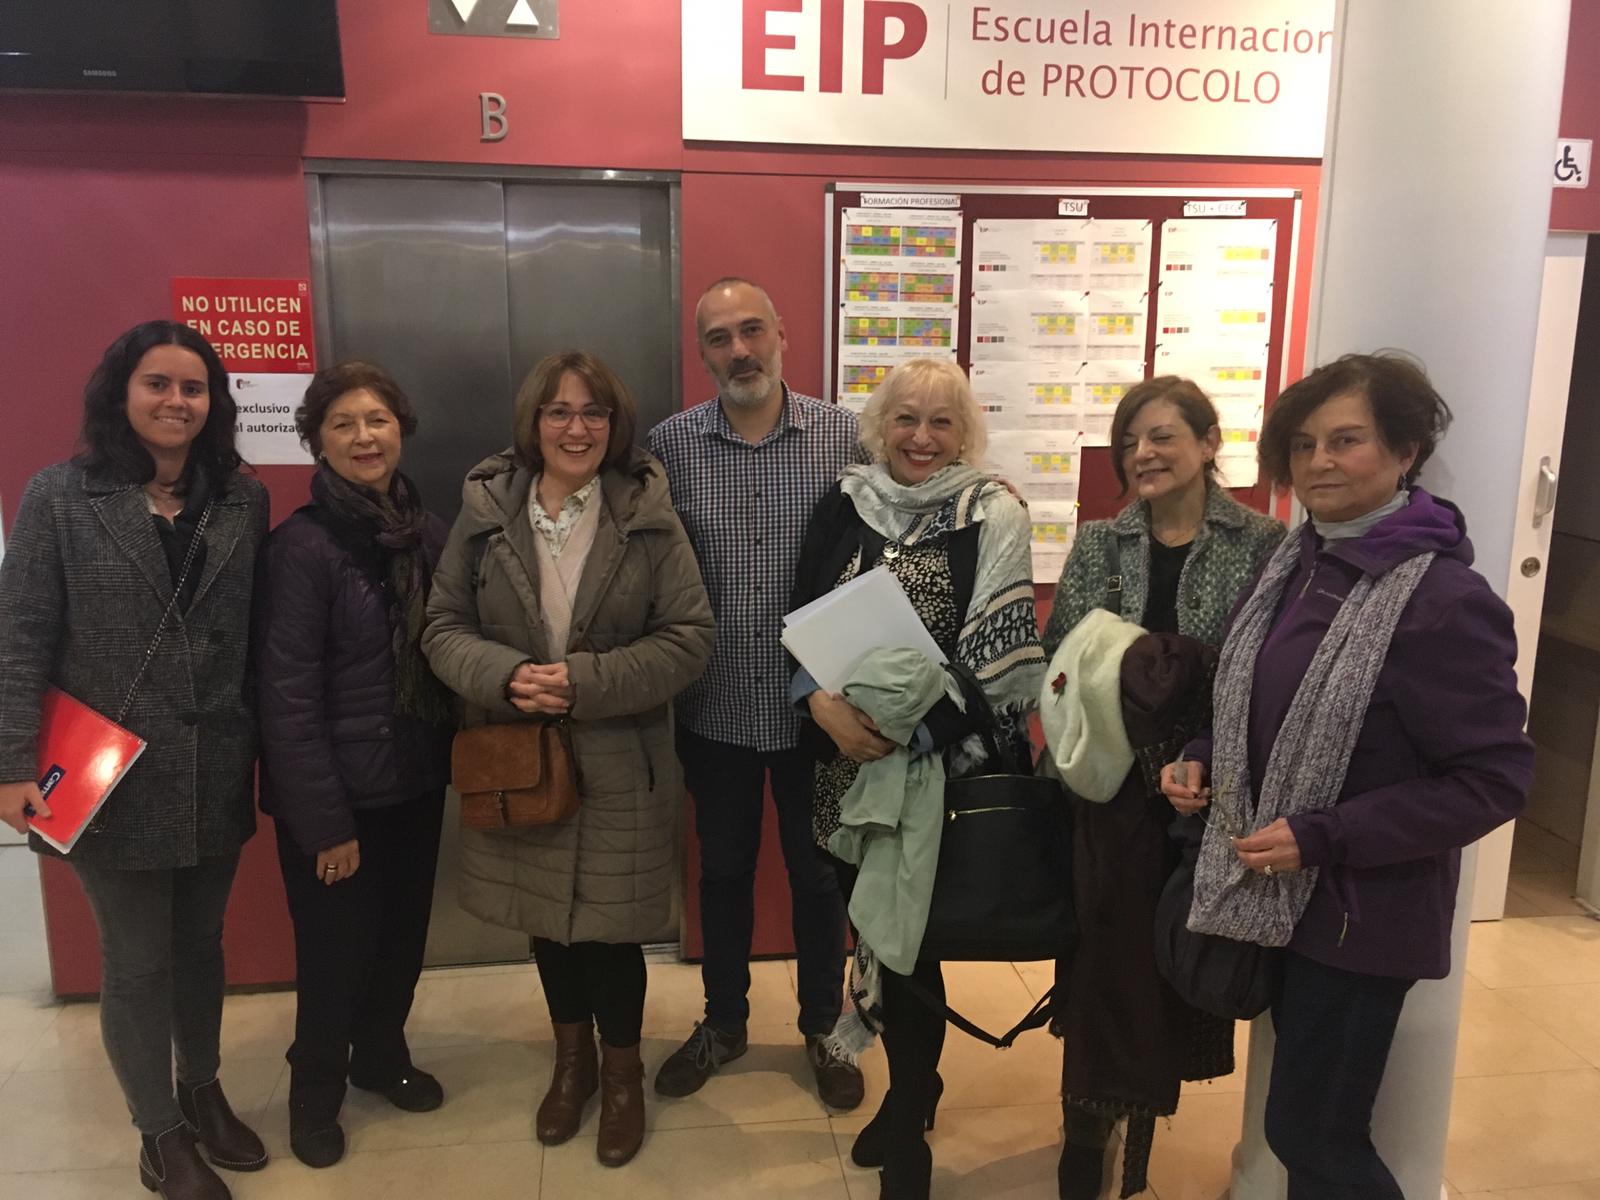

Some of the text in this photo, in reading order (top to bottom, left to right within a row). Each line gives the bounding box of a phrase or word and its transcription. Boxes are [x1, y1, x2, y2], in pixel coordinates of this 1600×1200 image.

[971, 6, 1112, 47] Escuela
[742, 0, 928, 95] EIP
[981, 59, 1280, 104] de PROTOCOLO
[480, 92, 508, 143] B
[1063, 201, 1084, 213] TSU
[182, 296, 301, 313] NO UTILICEN
[217, 320, 270, 336] CASO
[276, 320, 301, 336] DE
[211, 343, 308, 359] ERGENCIA
[236, 402, 290, 414] exclusivo
[246, 422, 297, 433] autoriza
[41, 771, 61, 794] Cam
